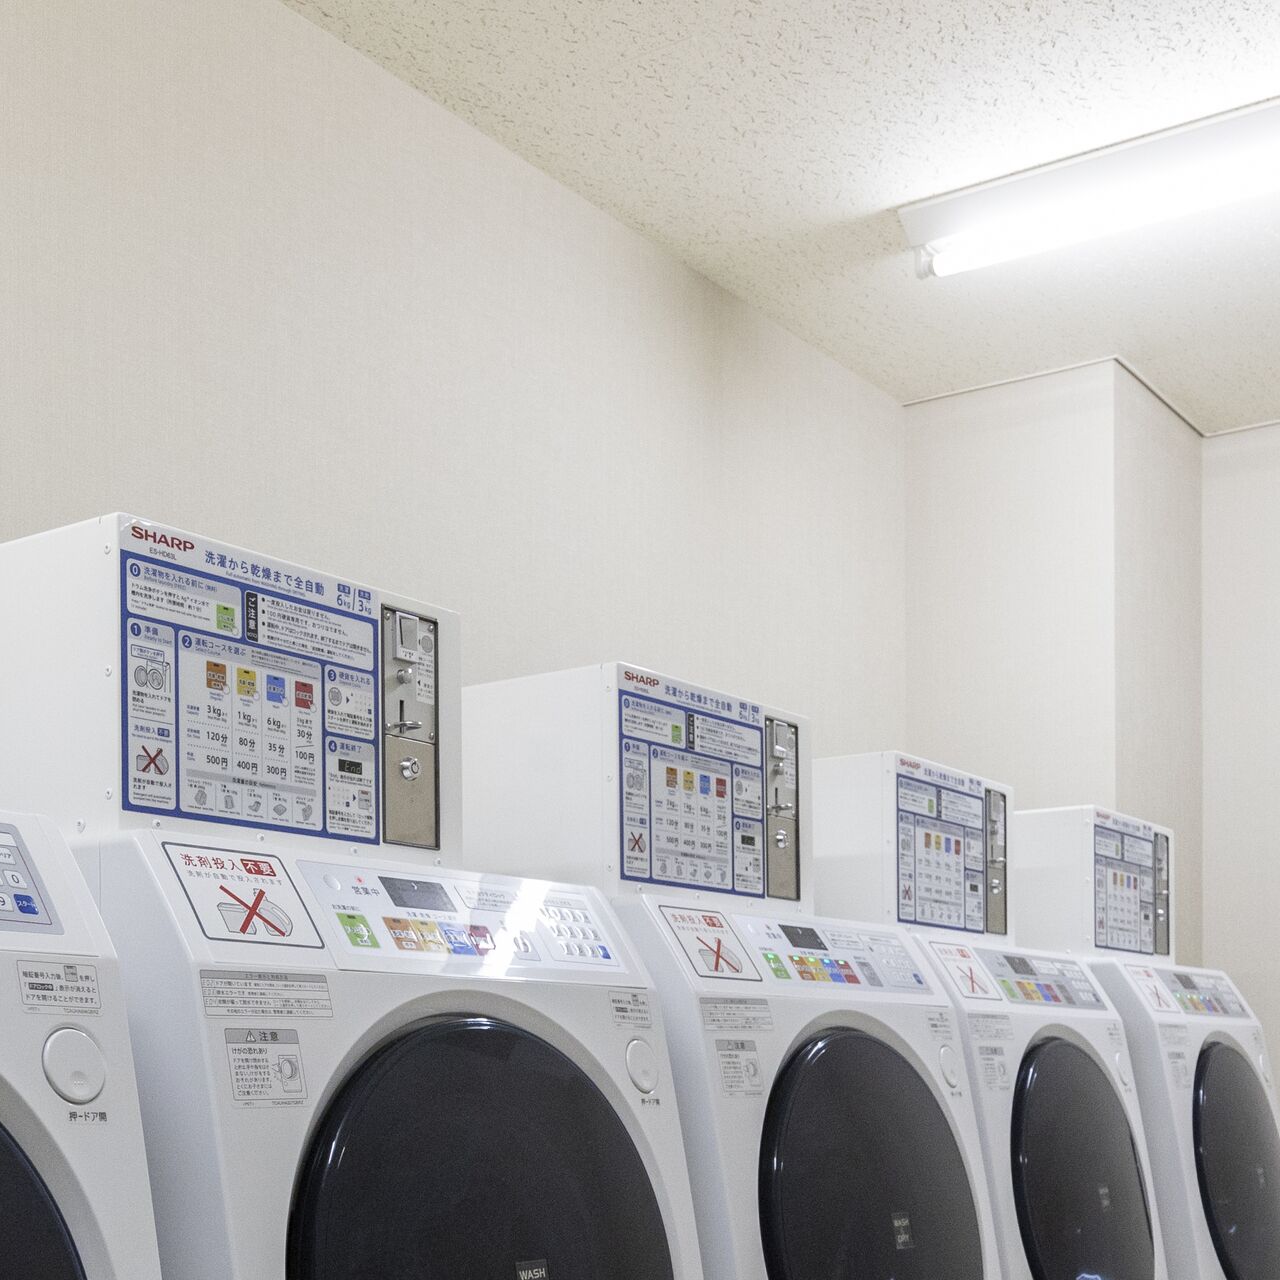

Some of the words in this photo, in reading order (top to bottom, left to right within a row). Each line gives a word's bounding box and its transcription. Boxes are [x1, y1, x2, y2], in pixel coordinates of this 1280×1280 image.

[131, 525, 195, 552] SHARP
[204, 550, 325, 597] 洗濯から乾燥まで全自動
[624, 670, 660, 688] SHARP
[181, 852, 243, 872] 洗剤投入
[11, 874, 20, 884] 0
[351, 885, 380, 898] 営業中
[258, 1031, 280, 1042] 注意
